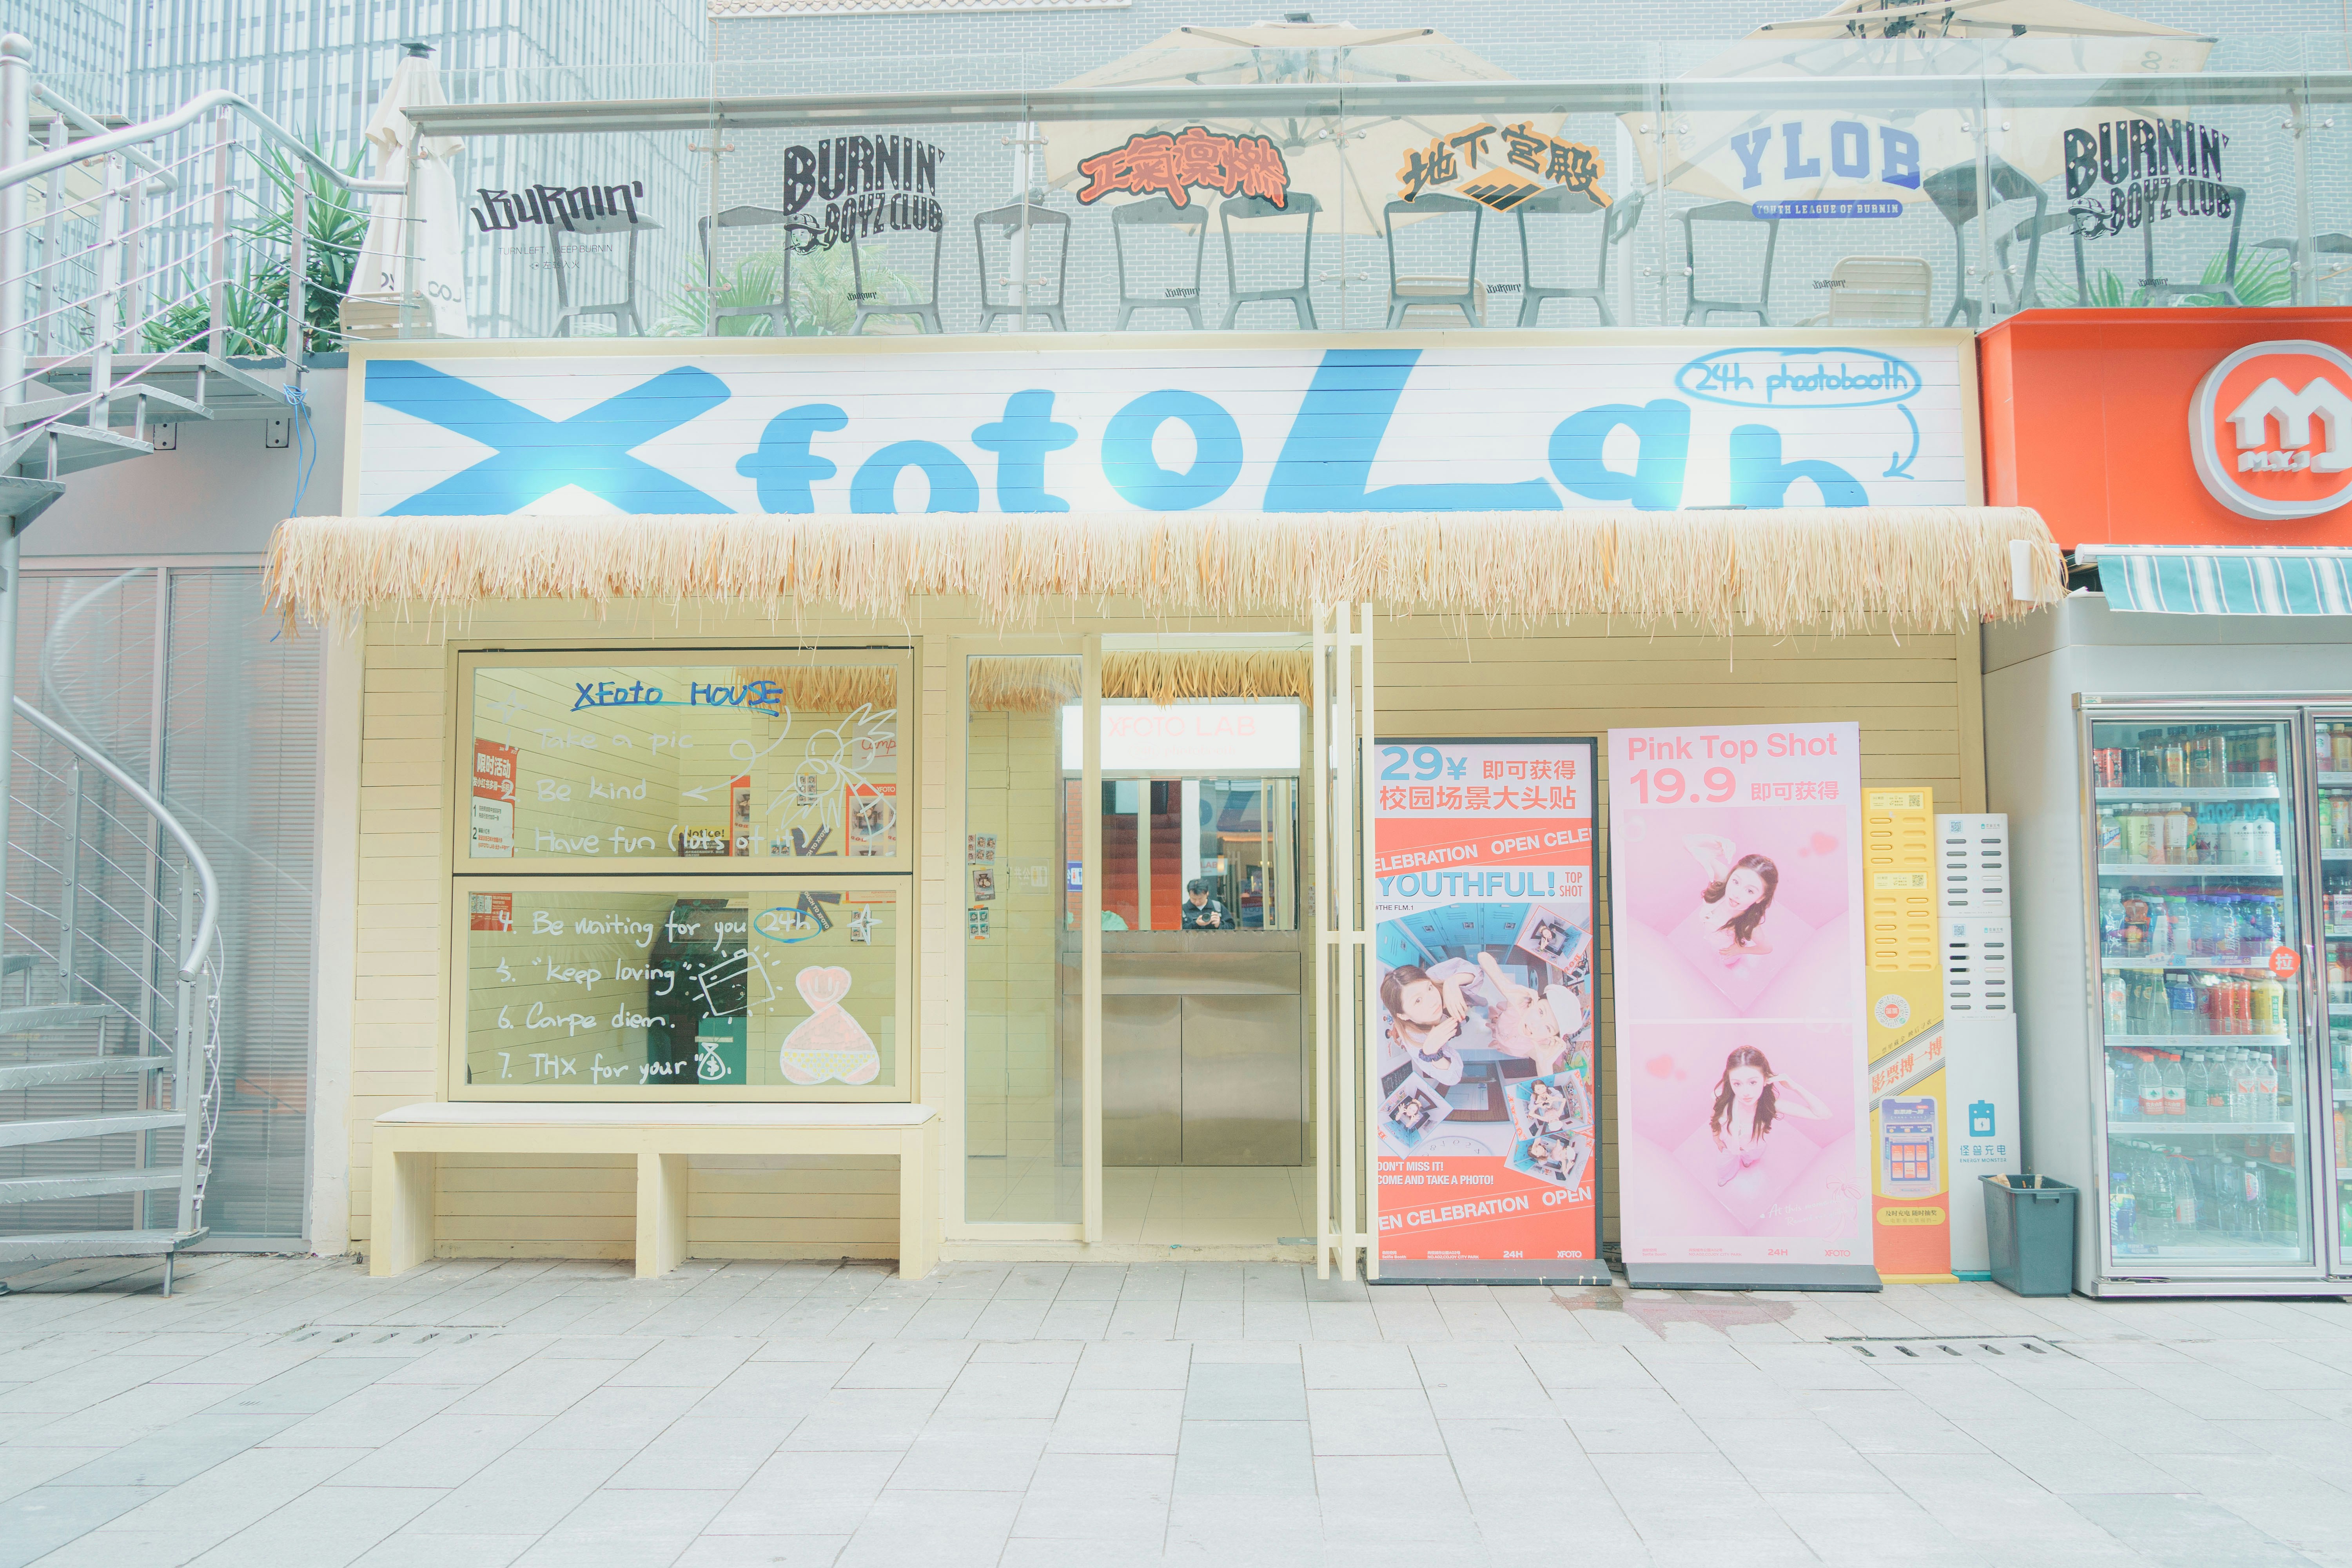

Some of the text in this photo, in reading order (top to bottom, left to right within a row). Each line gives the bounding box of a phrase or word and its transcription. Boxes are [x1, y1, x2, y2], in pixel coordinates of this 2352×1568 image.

[1730, 120, 1920, 190] YLOB
[2064, 118, 2229, 200] BURNIN'
[784, 135, 945, 216] BURNIN'
[1756, 204, 1898, 215] YOUTH LEAGUE OF BURNIN
[2110, 177, 2231, 236] BOYZ CLUB
[823, 192, 942, 251] BOYZ CLUB
[499, 247, 523, 255] TURN
[555, 245, 579, 254] KEEP
[579, 244, 613, 253] BURNIN
[543, 260, 580, 269] 左转入火
[1692, 363, 1754, 392] 24h
[691, 681, 783, 706] HOUSE
[1108, 716, 1256, 737] XFOTO LAB
[534, 728, 598, 750] Take
[612, 733, 632, 748] a
[648, 731, 693, 756] pic
[1628, 733, 1838, 764] Pink Top Shot
[477, 752, 511, 779] 限时活动
[1483, 759, 1576, 780] 即可获得
[501, 777, 646, 802] 2. Be kind
[1379, 785, 1577, 811] 校园场景大头贴
[1630, 766, 1839, 804] 19.9 即可获得
[535, 827, 599, 853] Have
[608, 827, 655, 854] fun
[1491, 835, 1540, 855] OPEN
[1379, 871, 1555, 897] YOUTHFUL!
[1564, 871, 1583, 883] TOP
[1559, 884, 1583, 897] SHOT
[499, 910, 811, 952] 4. Be waiting for you 24h
[817, 912, 830, 930] XFOTO
[497, 957, 516, 983] 5.
[2275, 953, 2294, 971] 拉
[498, 1001, 675, 1036] 6. Carpe diem.
[498, 1052, 687, 1085] 7. THX for your
[1871, 1035, 1943, 1094] 影票搏一搏
[1960, 1144, 2006, 1156] 怪兽充电
[1377, 1161, 1444, 1172] DON'T MISS IT!
[1377, 1175, 1494, 1185] COME AND TAKE A PHOTO!
[1406, 1195, 1529, 1227] CELEBRATION
[1542, 1186, 1592, 1206] OPEN
[1768, 1203, 1782, 1218] At
